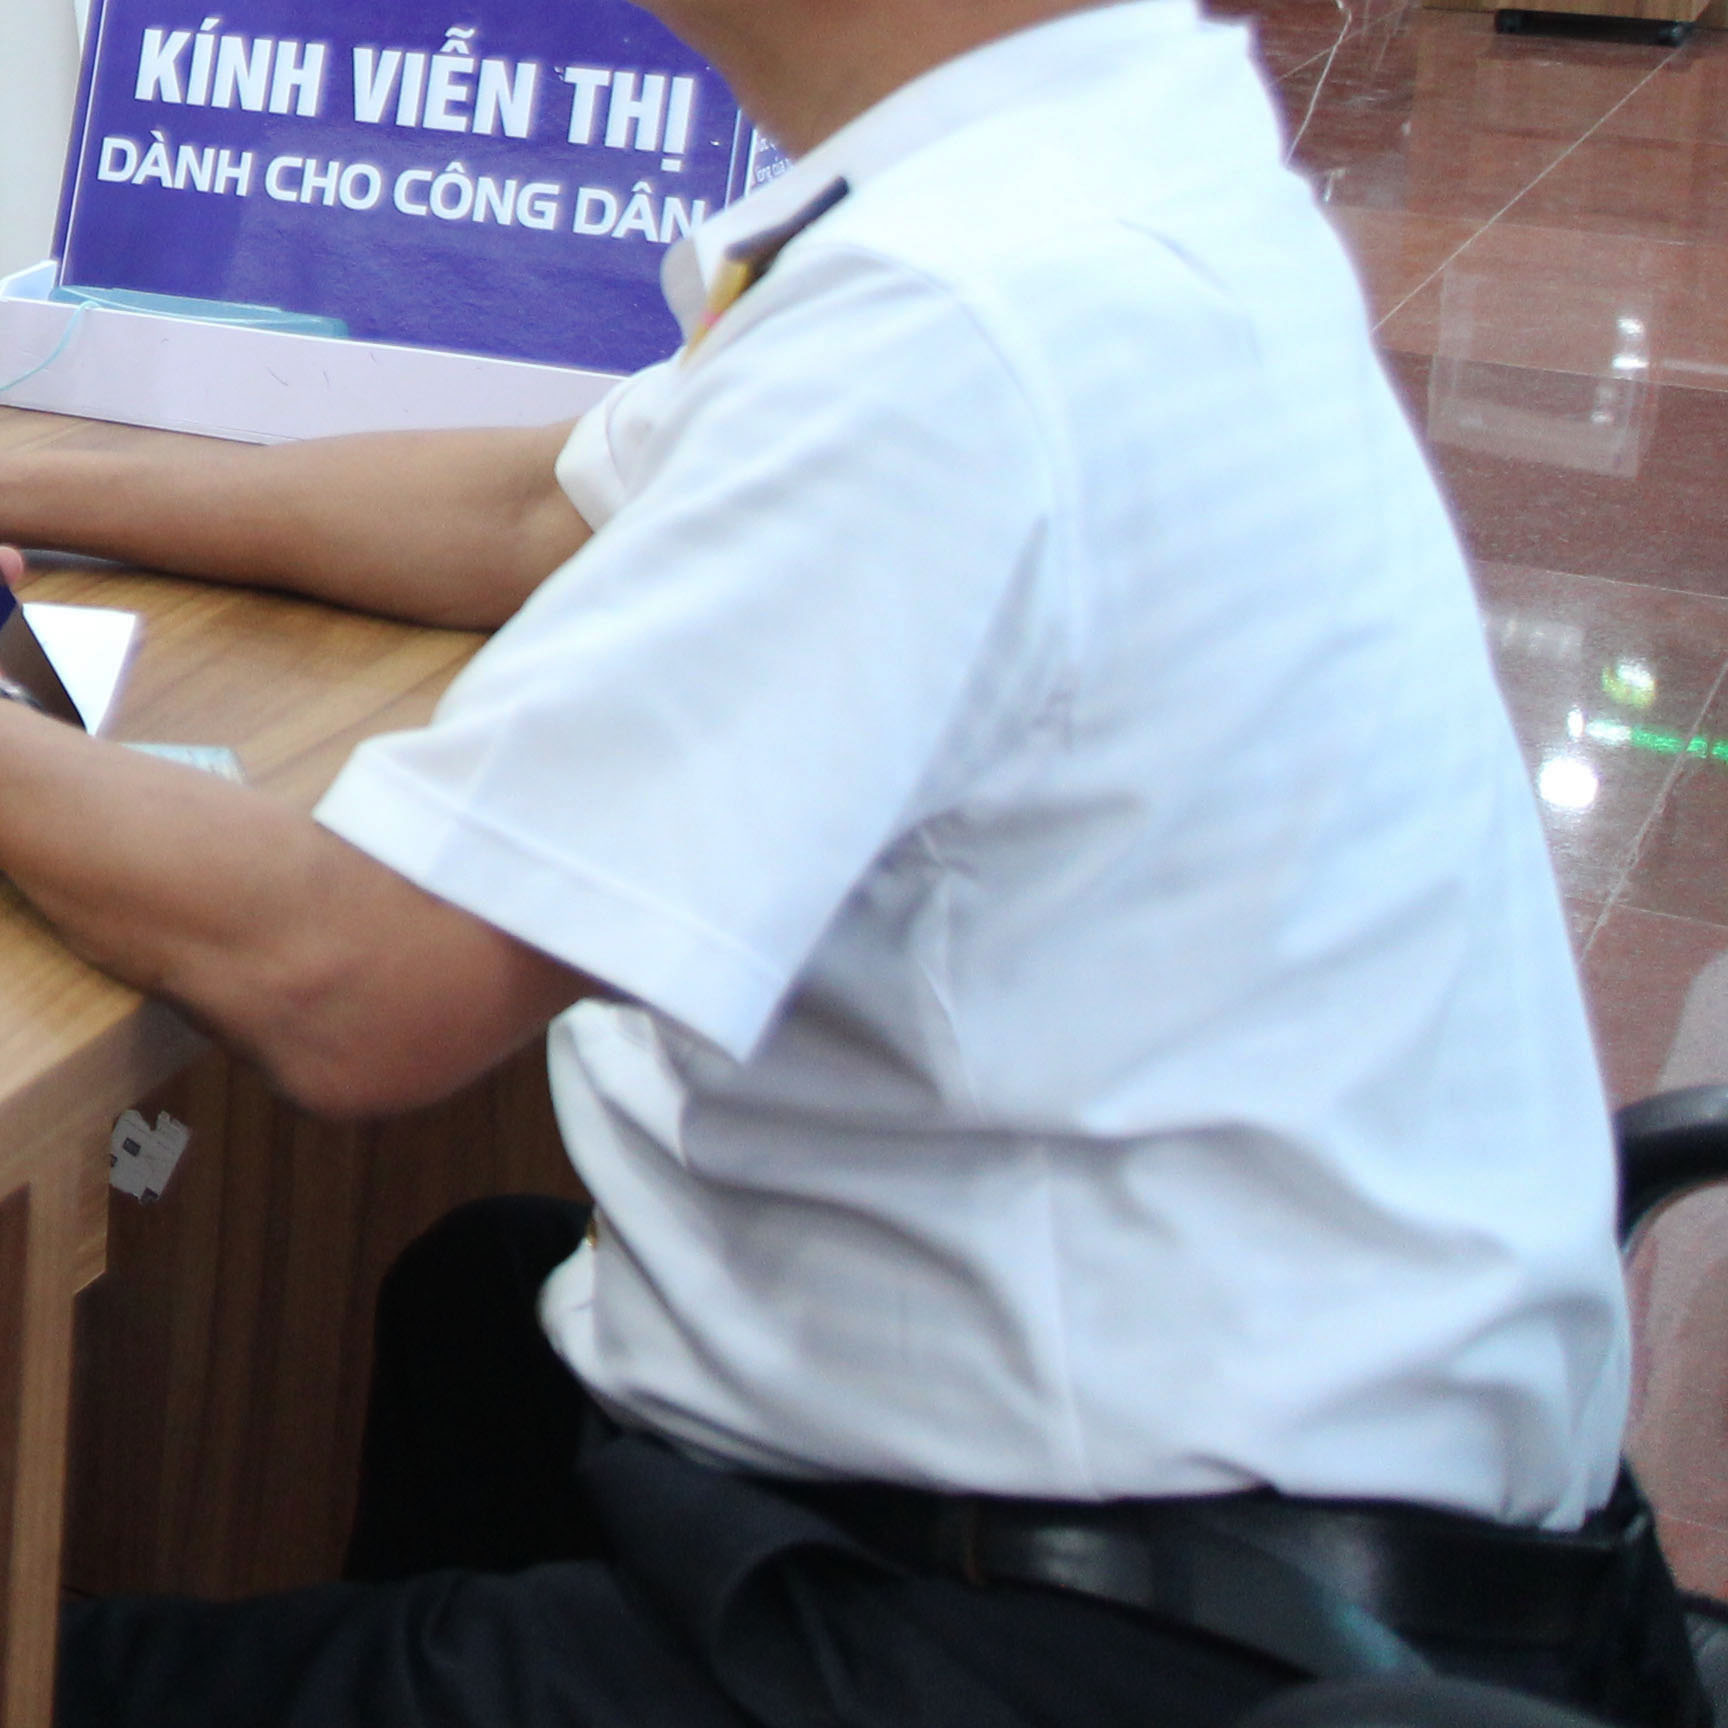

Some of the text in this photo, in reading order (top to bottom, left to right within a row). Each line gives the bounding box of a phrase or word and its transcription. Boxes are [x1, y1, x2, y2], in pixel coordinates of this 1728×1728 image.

[133, 16, 326, 119] KÍNH
[351, 25, 538, 140] VIỄN
[563, 64, 696, 173] THỊ
[96, 130, 709, 246] DÀNH CHO CÔNG DÂN
